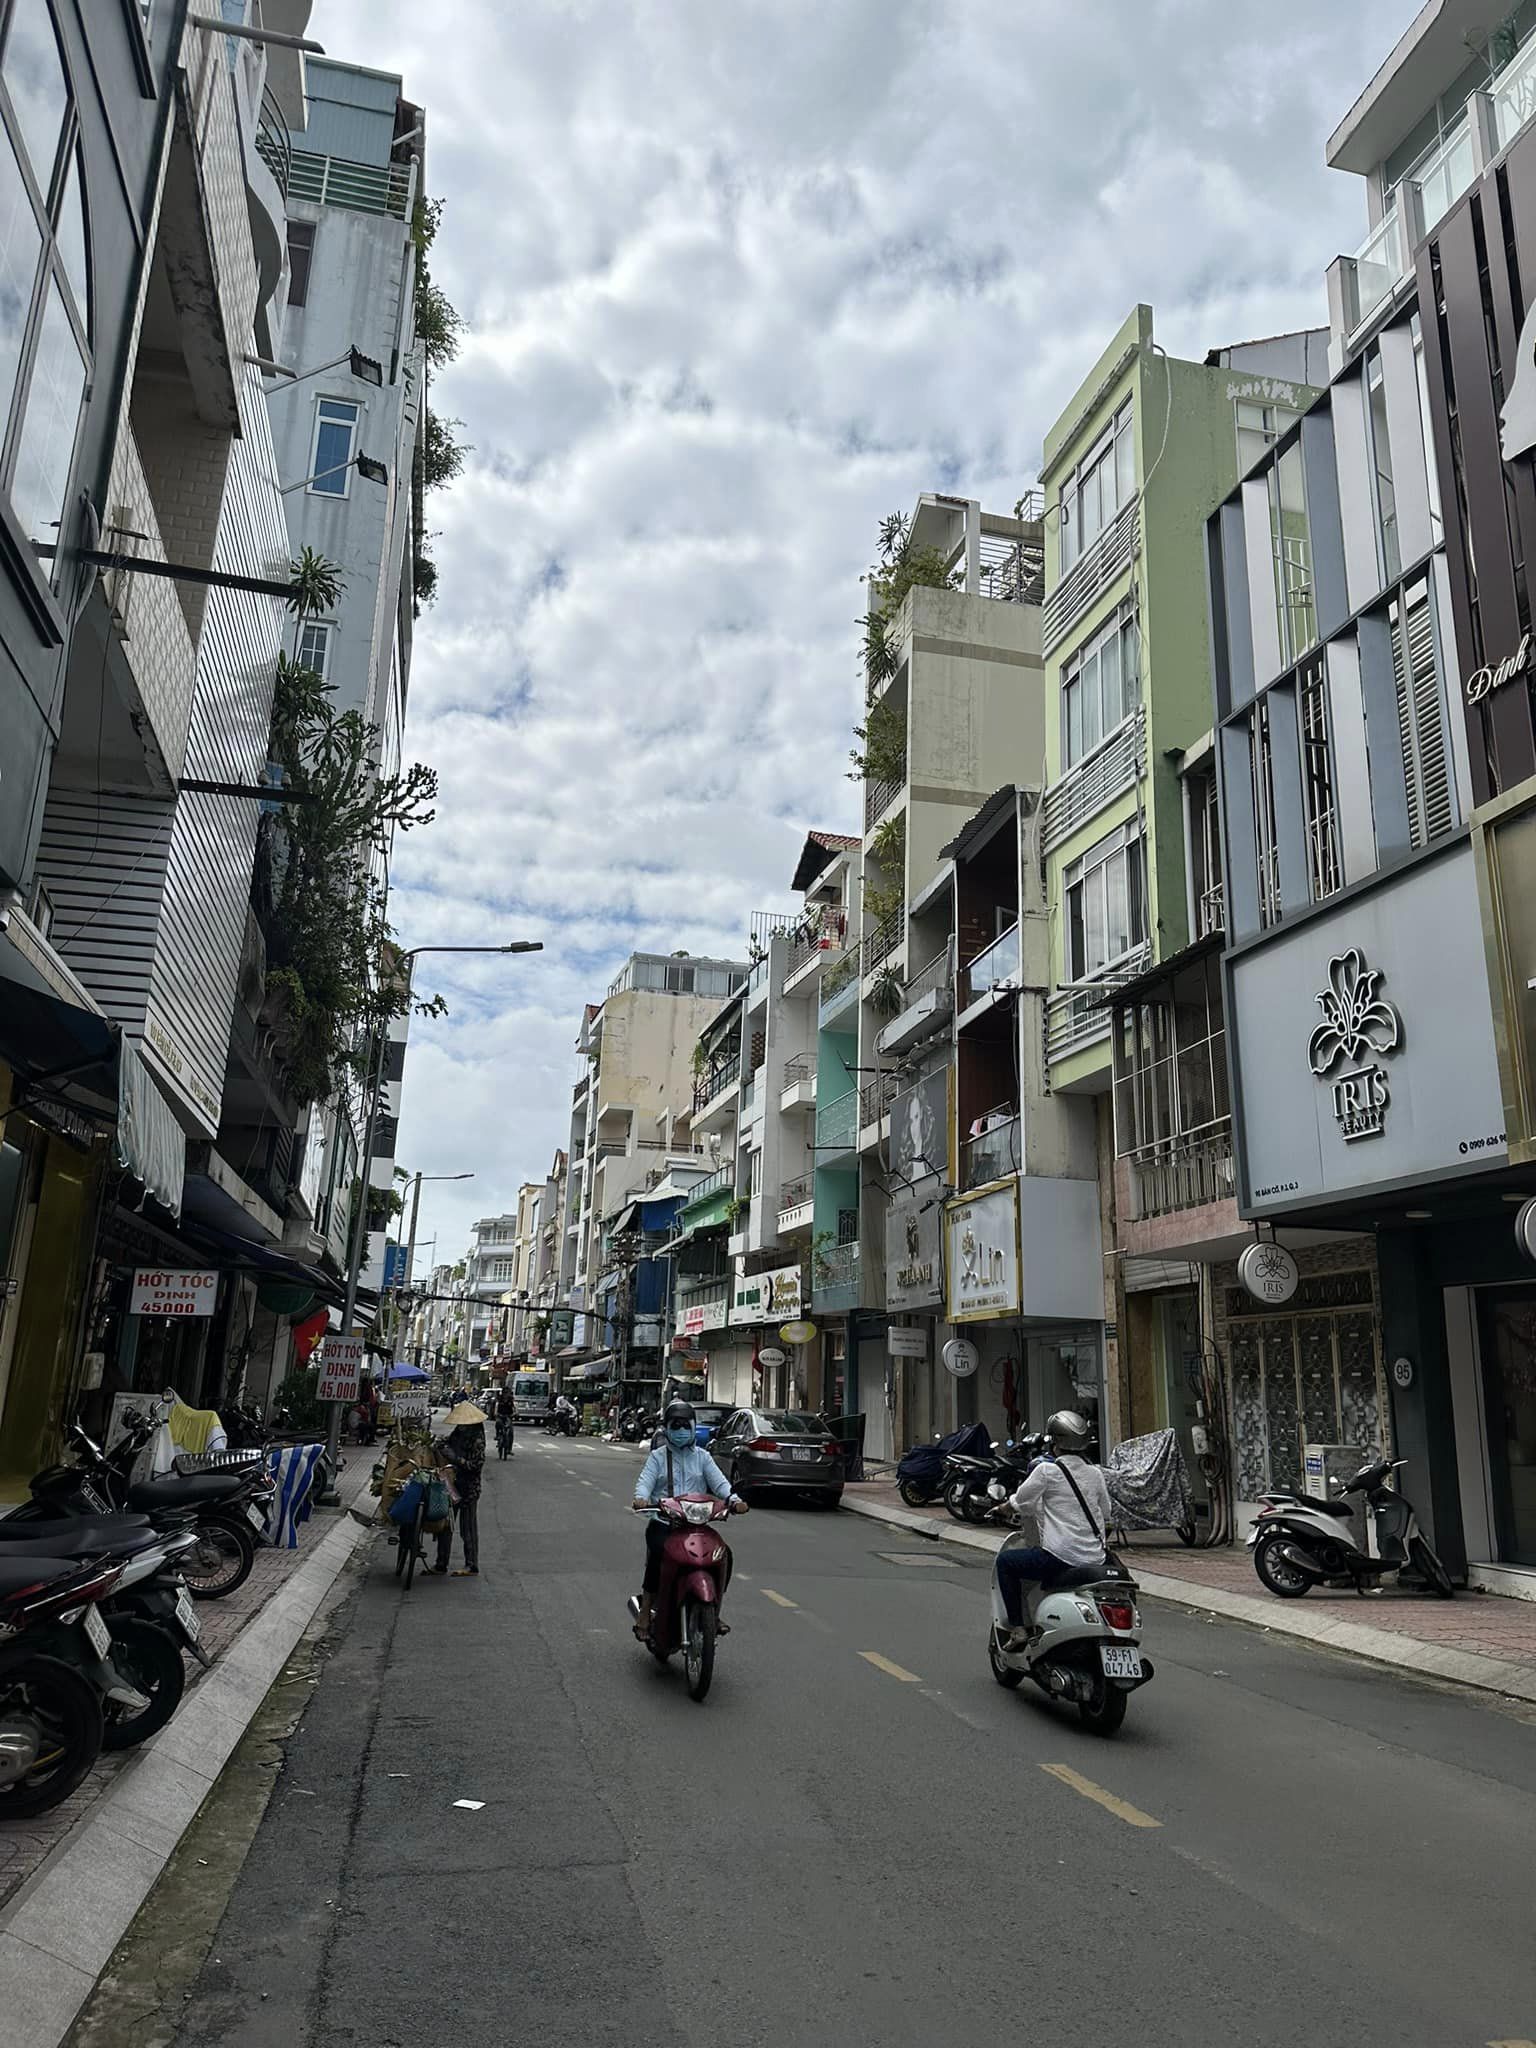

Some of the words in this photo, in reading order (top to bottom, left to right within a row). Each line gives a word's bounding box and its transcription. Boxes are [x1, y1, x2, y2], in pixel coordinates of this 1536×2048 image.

[1330, 1070, 1389, 1119] IRIS
[1339, 1110, 1383, 1133] BEAUTY
[179, 1271, 215, 1288] TÓC
[1263, 1282, 1284, 1294] IRIS
[955, 1359, 969, 1369] Lin
[1396, 1364, 1410, 1380] 95
[320, 1381, 357, 1400] 45.000
[1106, 1649, 1133, 1662] 59-F1
